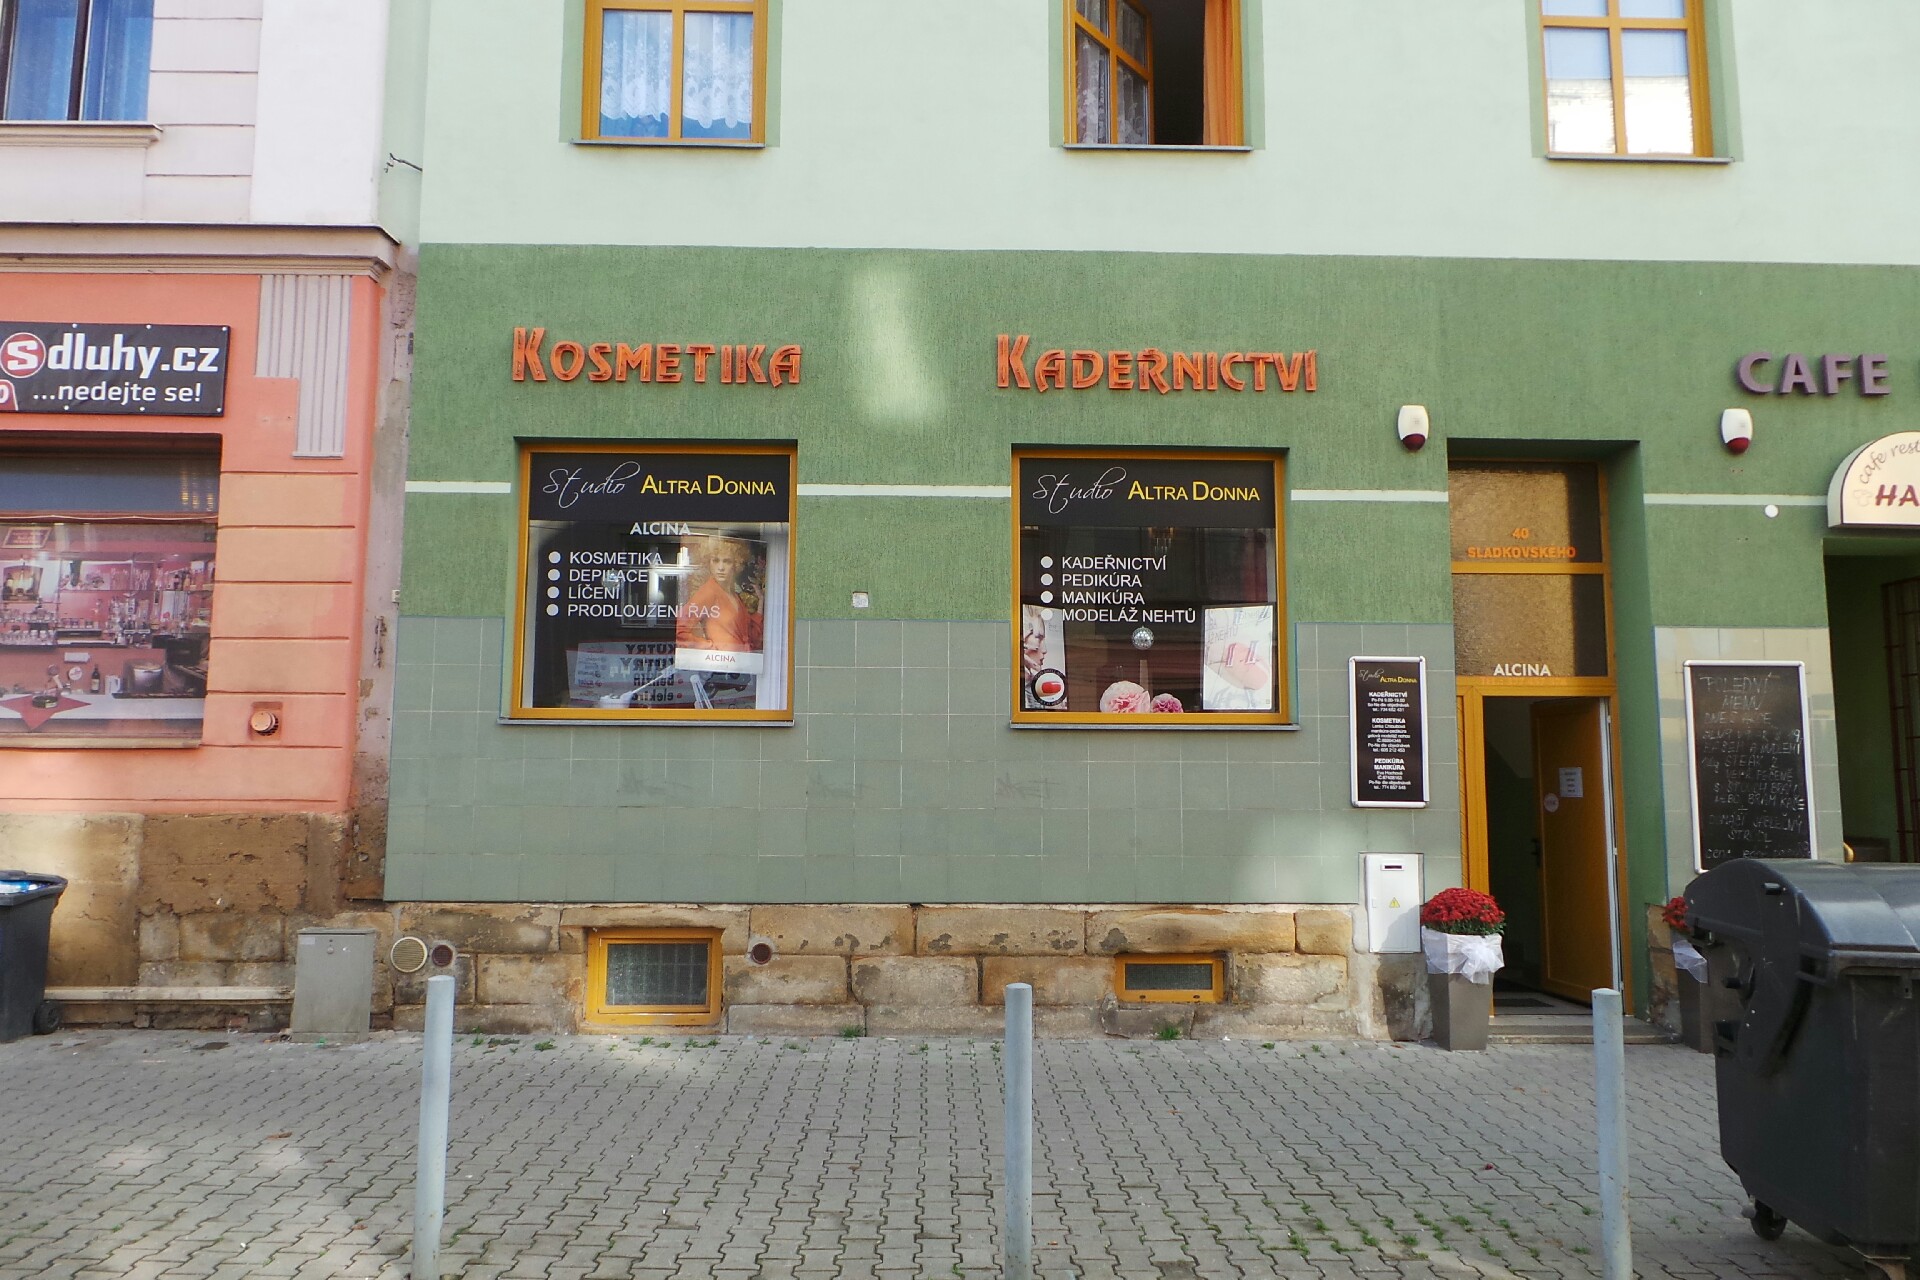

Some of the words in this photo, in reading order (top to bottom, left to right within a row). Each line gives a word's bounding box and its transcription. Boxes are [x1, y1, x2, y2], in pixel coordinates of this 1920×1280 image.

[512, 326, 802, 388] KOSMETIKA
[1737, 351, 1892, 396] CAFE
[164, 382, 202, 402] se!
[542, 460, 641, 509] Studio
[1032, 466, 1127, 515] Studio
[629, 522, 692, 536] ALCINA
[1512, 527, 1530, 540] 40
[569, 551, 664, 566] KOSMETIKA
[1061, 554, 1167, 571] KADEŘNICTVÍ
[569, 569, 649, 583] DEPILACE
[1061, 571, 1143, 588] PEDIKÚRA
[568, 584, 621, 600] LÍČENÍ
[1061, 588, 1145, 605] MANIKÚRA
[567, 602, 684, 618] PRODLOUŽENÍ
[688, 602, 721, 618] ŘAS
[1061, 606, 1139, 623] MODELÁŽ
[1142, 606, 1197, 624] NEHTŮ
[705, 654, 736, 664] ALCINA
[1493, 663, 1552, 677] ALCINA
